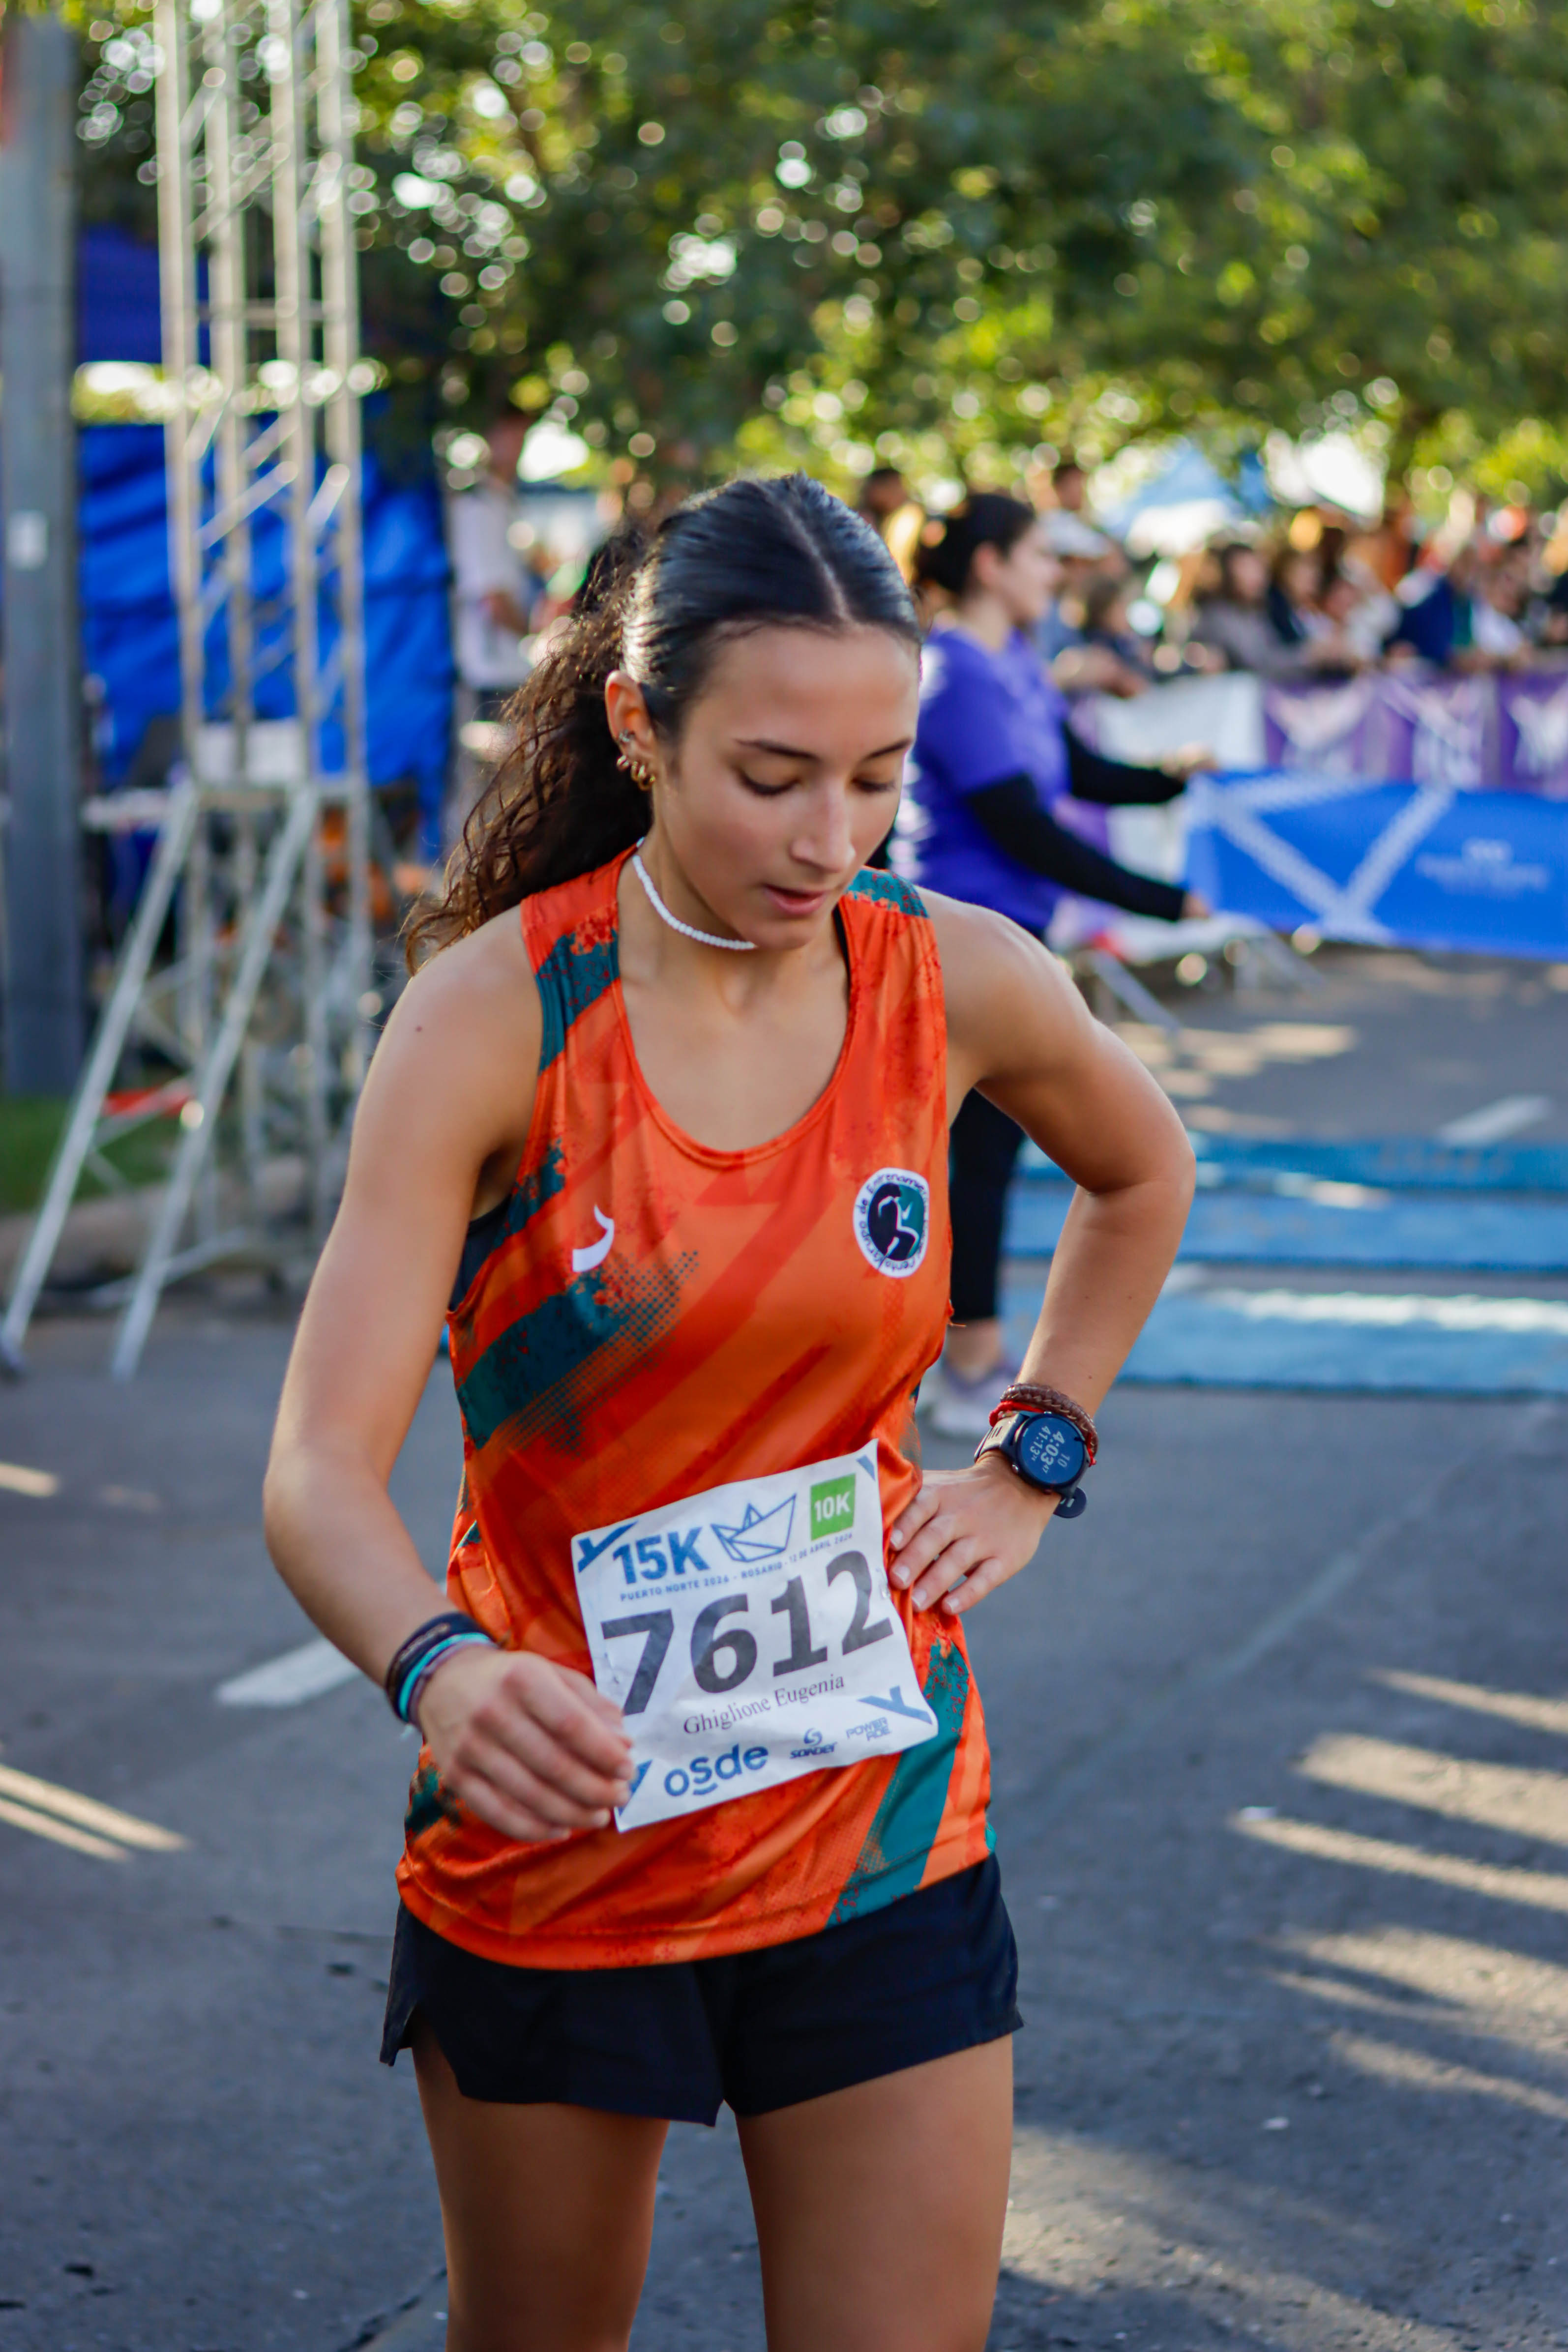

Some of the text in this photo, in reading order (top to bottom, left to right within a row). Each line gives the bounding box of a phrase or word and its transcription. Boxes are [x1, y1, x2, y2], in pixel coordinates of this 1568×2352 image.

[858, 1199, 868, 1214] de
[814, 1492, 851, 1521] 10K
[613, 1526, 710, 1585] 15K
[620, 1588, 662, 1601] PUERTO
[666, 1581, 699, 1593] NORTE
[741, 1561, 783, 1578] ROSARIO
[810, 1540, 830, 1554] ABRIL
[600, 1550, 894, 1716] 7612
[683, 1674, 844, 1734] Ghiglione Eugenia
[664, 1743, 769, 1796] osde
